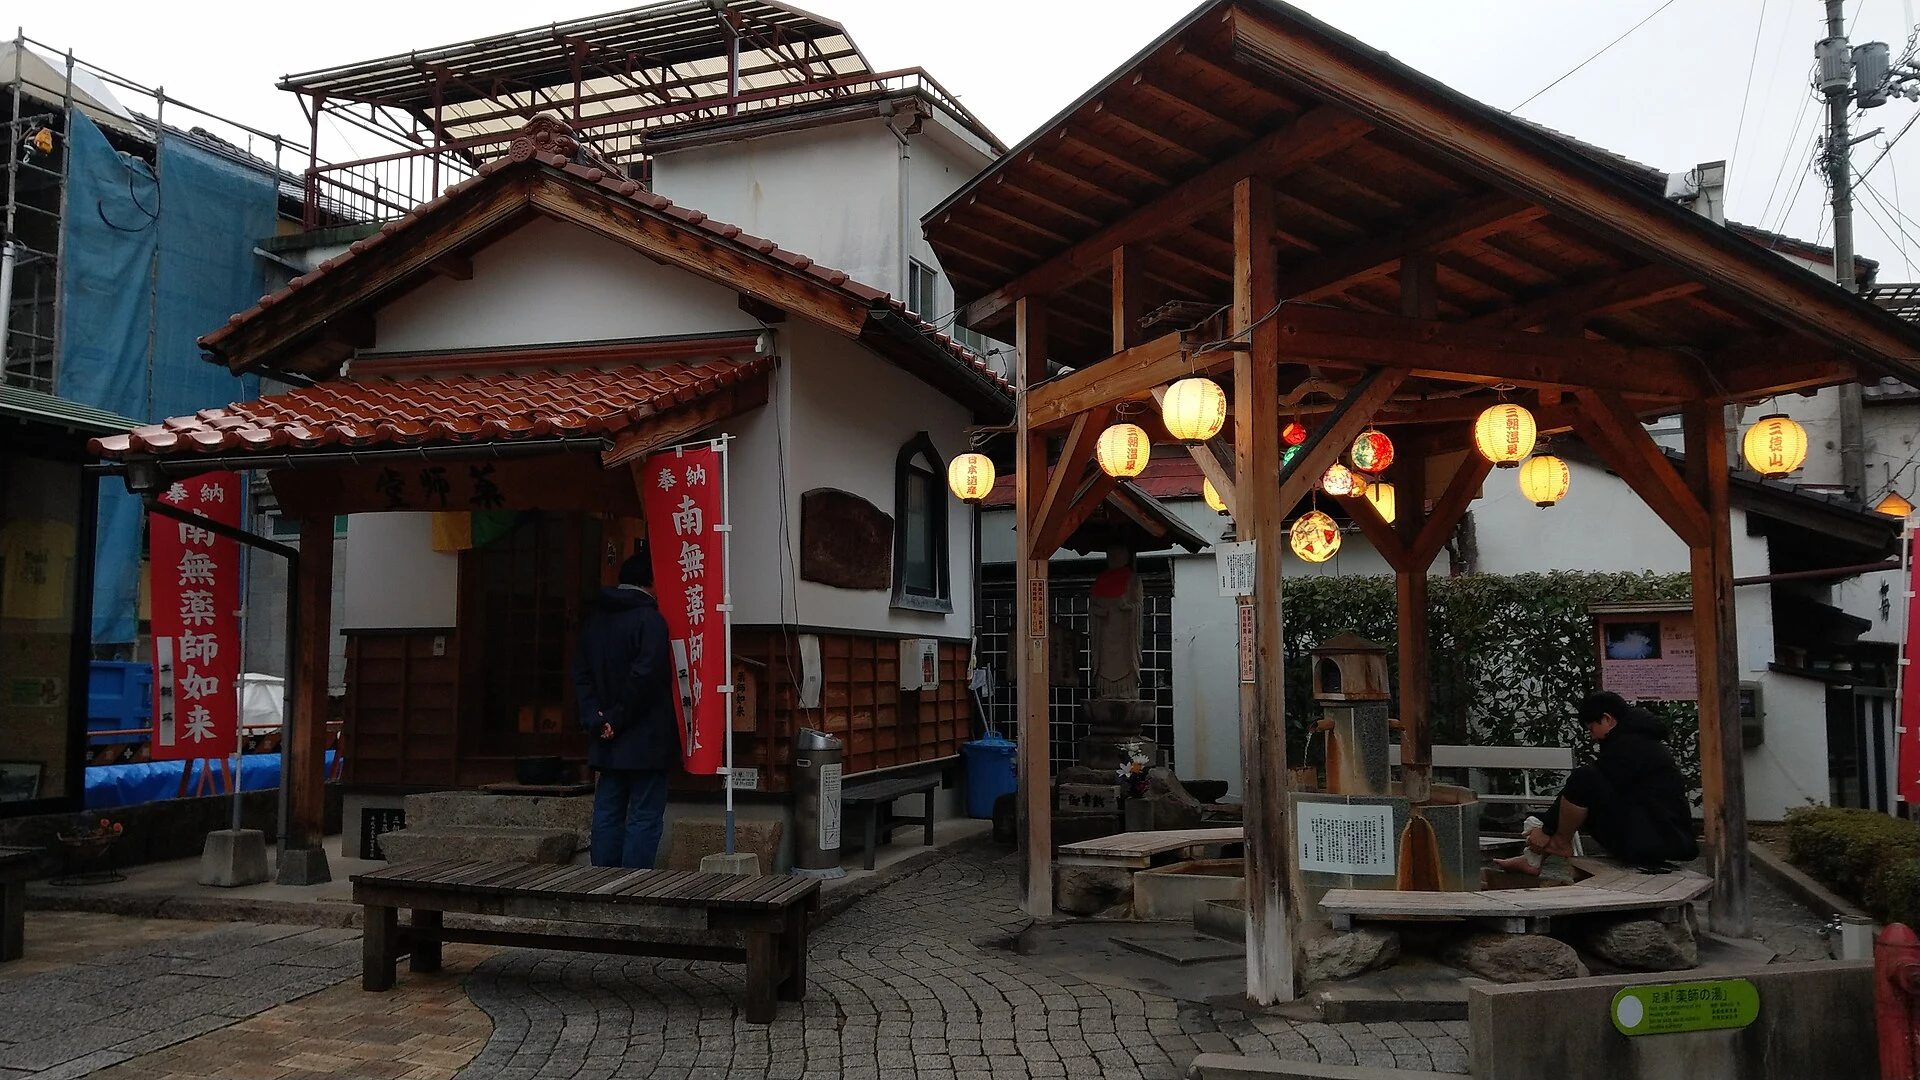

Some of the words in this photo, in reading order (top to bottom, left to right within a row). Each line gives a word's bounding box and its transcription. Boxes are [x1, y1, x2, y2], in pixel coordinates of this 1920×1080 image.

[1125, 427, 1138, 471] 三朝温泉
[1768, 421, 1784, 468] 三徳山
[166, 481, 225, 505] 奉納
[657, 462, 707, 493] 奉納
[966, 455, 978, 495] 日本遺産
[176, 508, 220, 745] 南無薬師如来
[1652, 986, 1728, 1004] 足湯「薬師の湯」
